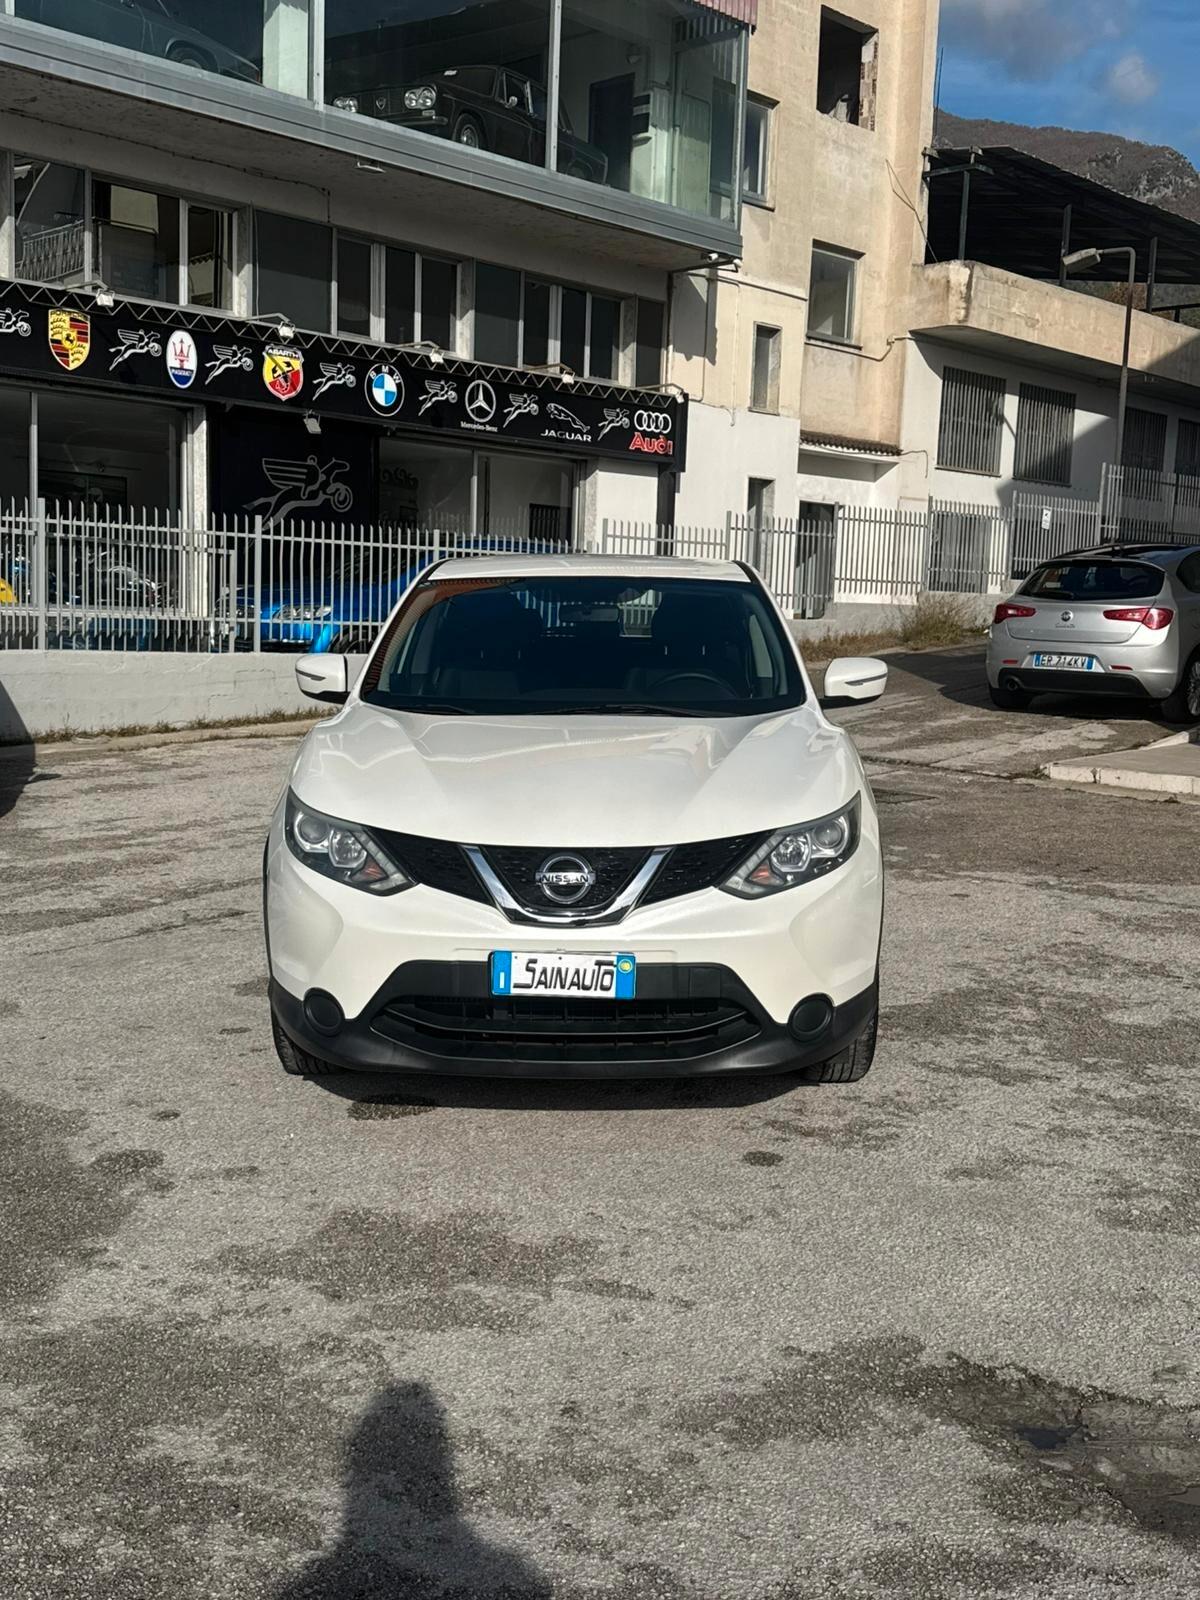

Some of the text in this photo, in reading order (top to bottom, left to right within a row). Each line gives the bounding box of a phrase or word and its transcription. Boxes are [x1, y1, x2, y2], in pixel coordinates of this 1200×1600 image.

[268, 348, 300, 359] ABARTH
[369, 365, 402, 384] BMW
[540, 429, 592, 442] JAGUAR
[541, 874, 589, 883] NISSAN
[512, 958, 616, 992] SAINAUTO
